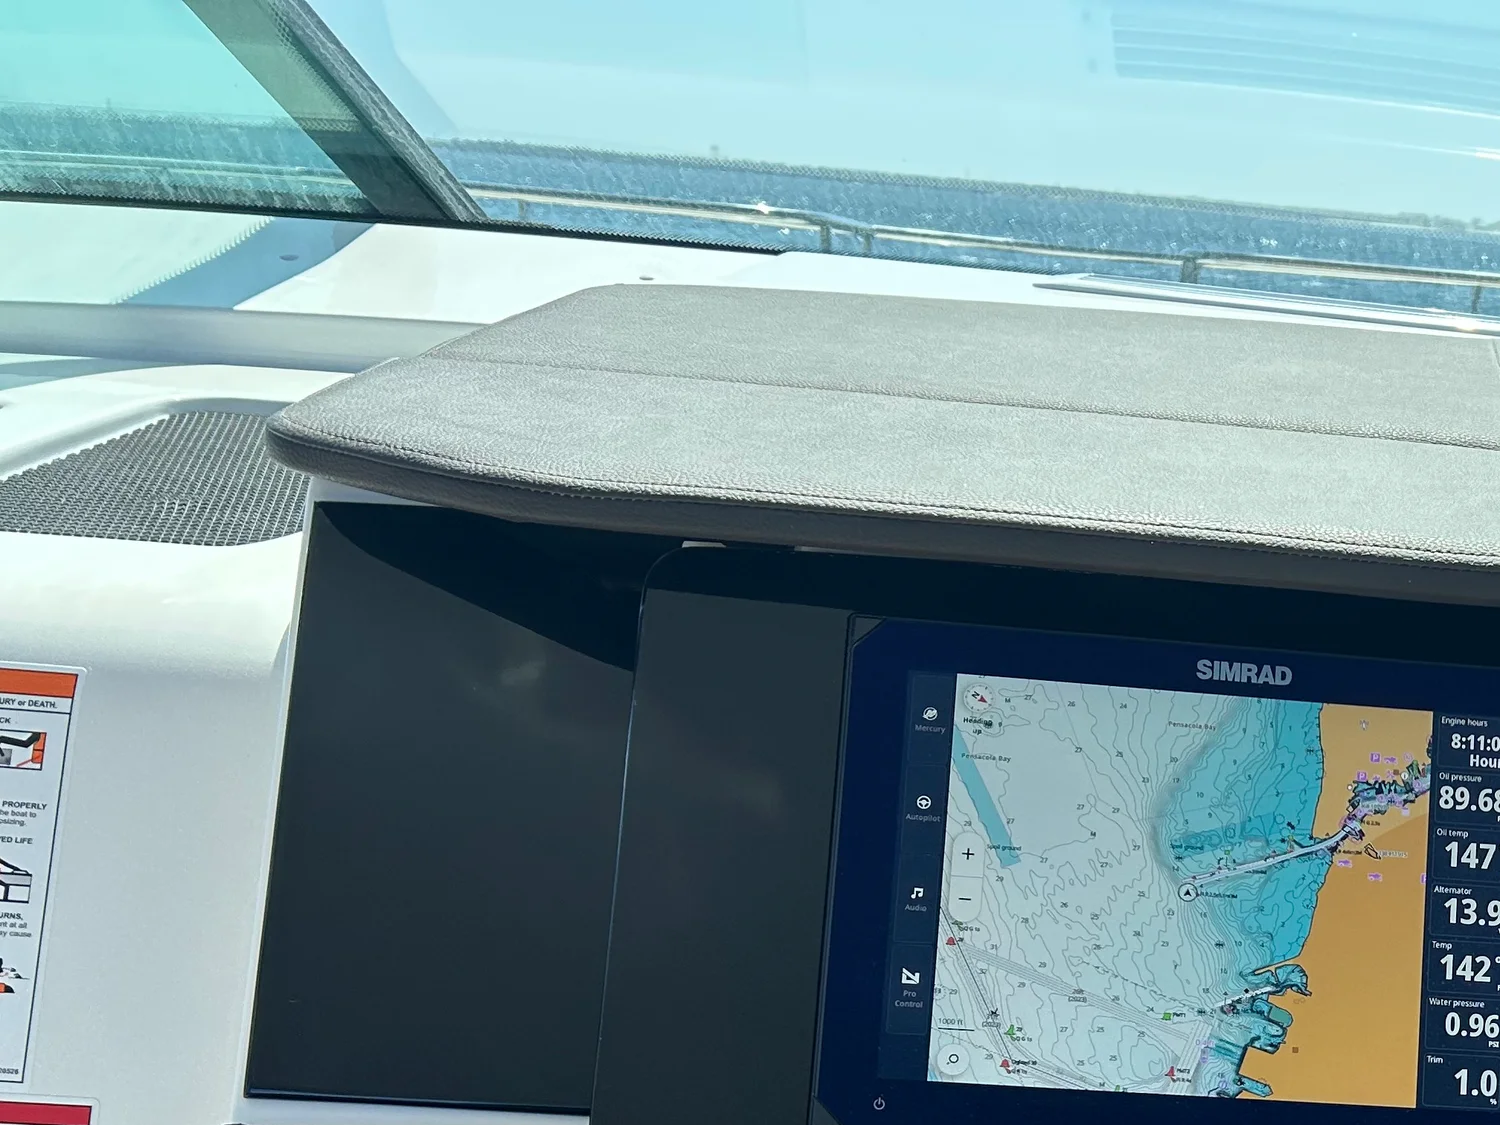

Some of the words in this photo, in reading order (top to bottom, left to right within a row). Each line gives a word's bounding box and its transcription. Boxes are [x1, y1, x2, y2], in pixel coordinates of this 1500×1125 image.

[1196, 659, 1293, 686] SIMRAD
[28, 700, 57, 709] DEATH.
[1168, 721, 1202, 730] Pensacola
[1204, 723, 1216, 732] Bay
[1441, 716, 1466, 727] Engine
[1467, 718, 1488, 727] hours
[915, 724, 946, 734] Mercury
[1451, 773, 1482, 782] pressure
[2, 801, 47, 810] PROPERLY
[905, 813, 941, 823] Autopilot
[1448, 829, 1469, 838] temp
[15, 837, 33, 845] LIFE
[1434, 885, 1472, 895] Alternator
[905, 903, 927, 912] Audio
[1432, 940, 1452, 950] Temp
[903, 990, 917, 998] Pro
[894, 1000, 924, 1009] Control
[1429, 998, 1452, 1007] Water
[1452, 999, 1485, 1009] pressure
[1445, 1012, 1500, 1038] 0.96
[1427, 1055, 1443, 1064] Trim
[1454, 1069, 1498, 1097] 1.0
